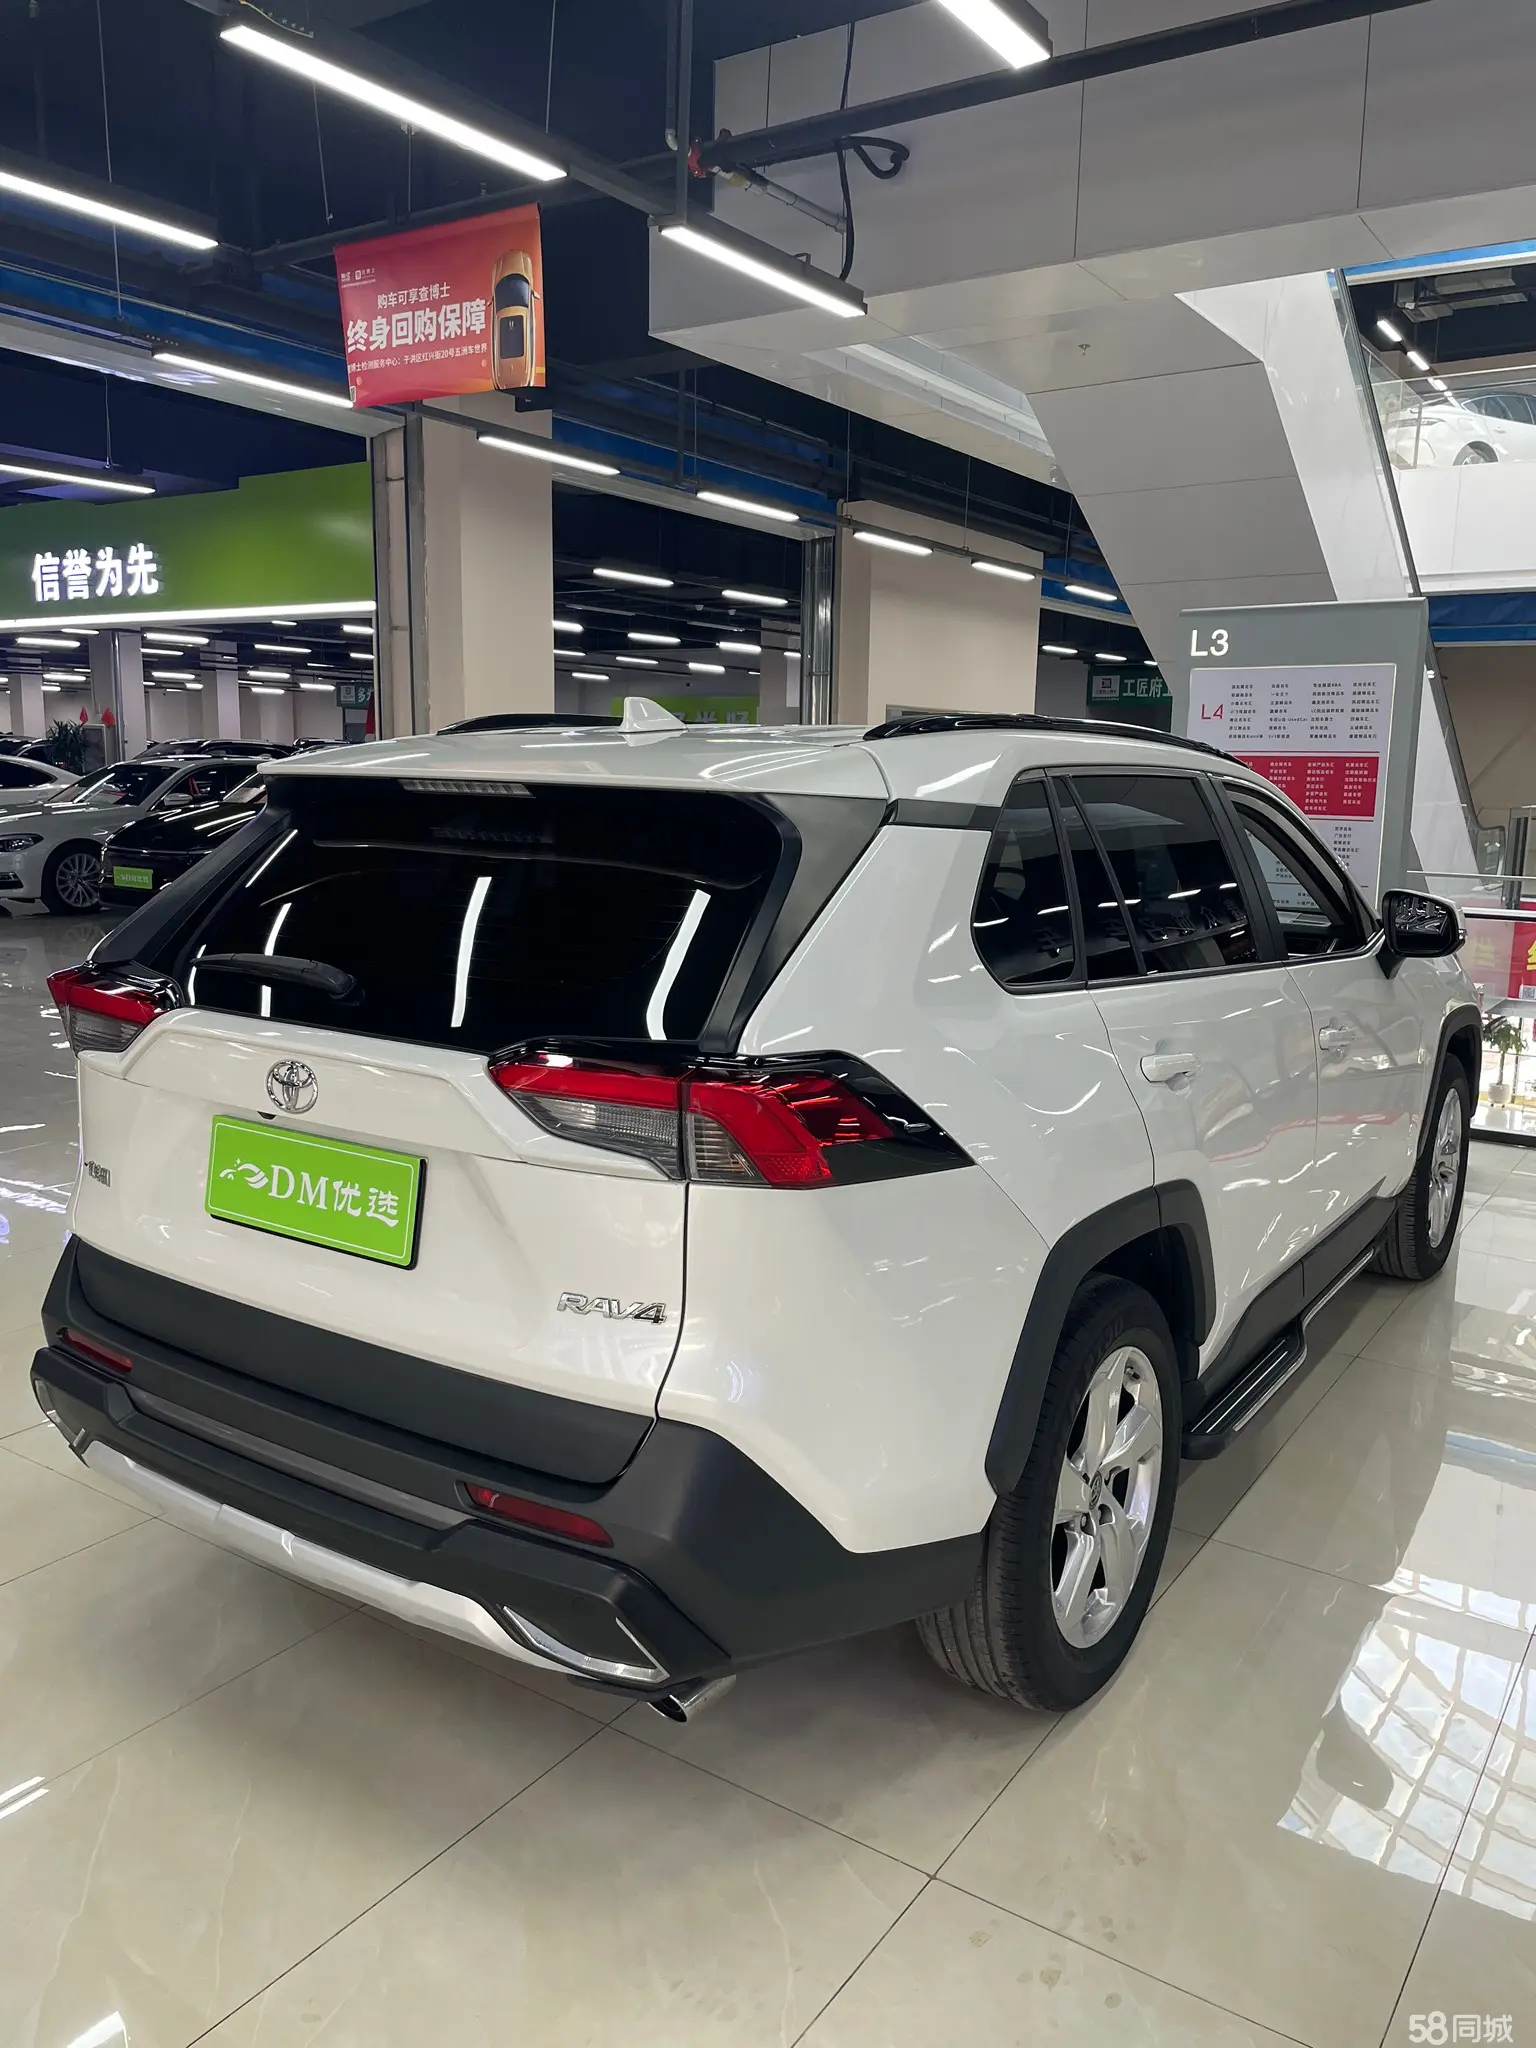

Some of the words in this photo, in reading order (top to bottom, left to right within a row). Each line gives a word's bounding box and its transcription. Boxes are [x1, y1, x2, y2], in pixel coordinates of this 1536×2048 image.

[377, 282, 451, 309] 购车可享查博士
[347, 298, 487, 353] 终身回购保障
[32, 543, 160, 602] 信誉为先
[1190, 628, 1229, 656] L3
[1201, 703, 1223, 720] L4
[267, 1163, 400, 1228] DM优选
[556, 1291, 668, 1325] RAV4
